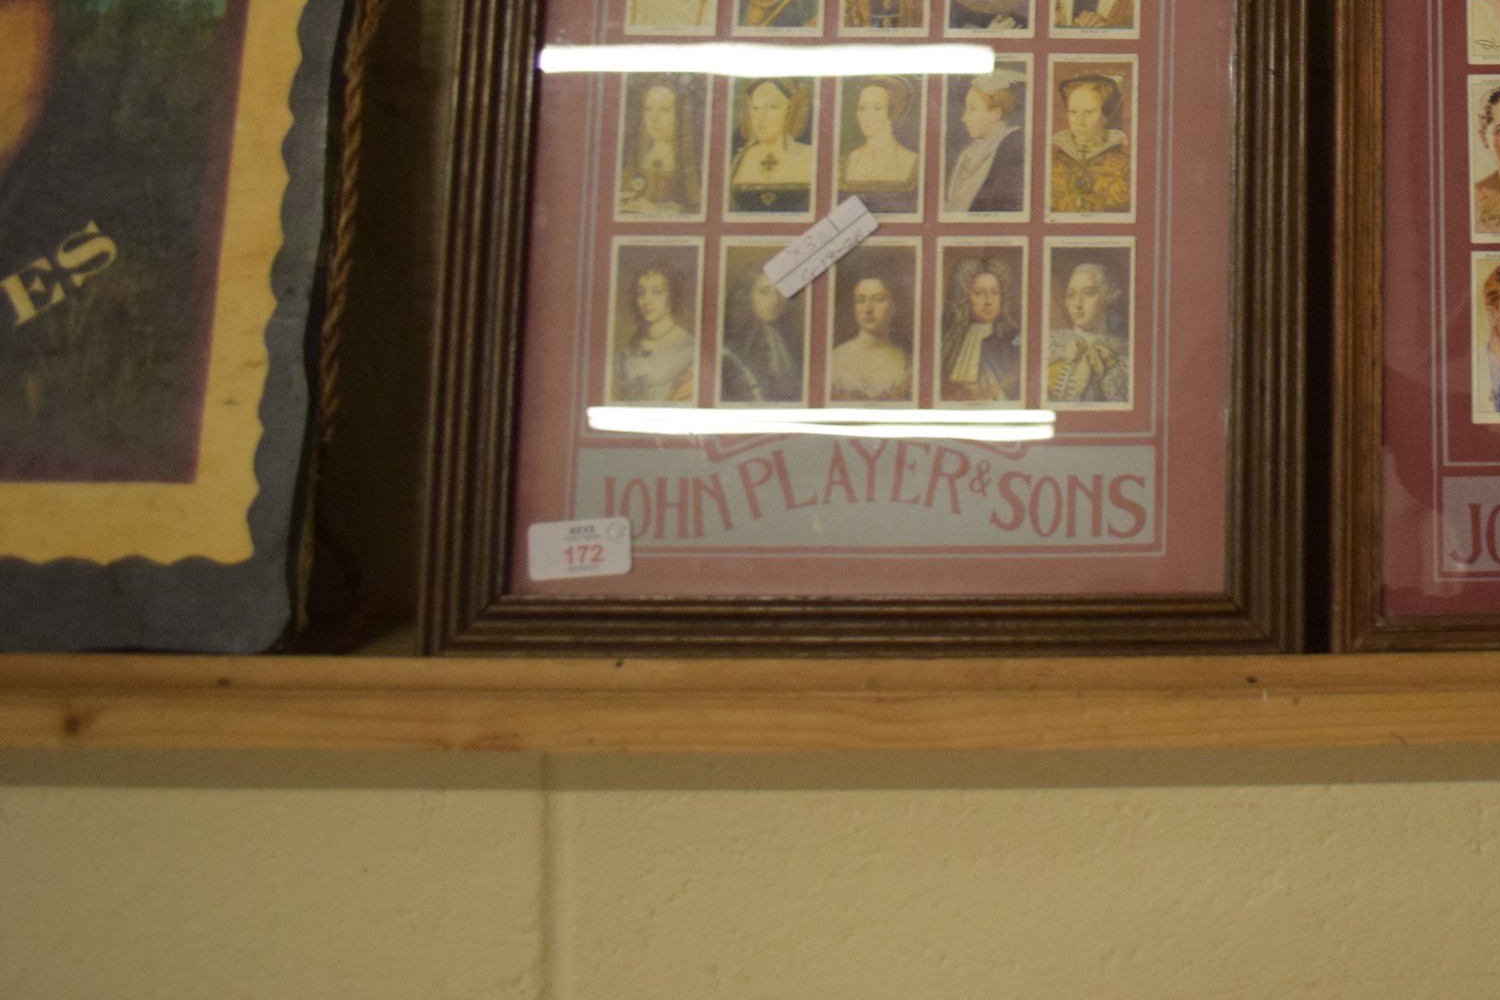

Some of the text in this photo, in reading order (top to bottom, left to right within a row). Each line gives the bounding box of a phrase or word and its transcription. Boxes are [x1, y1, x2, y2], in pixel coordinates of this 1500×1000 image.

[737, 437, 970, 519] PLAYER
[990, 470, 1148, 538] SONS
[563, 543, 604, 565] 172
